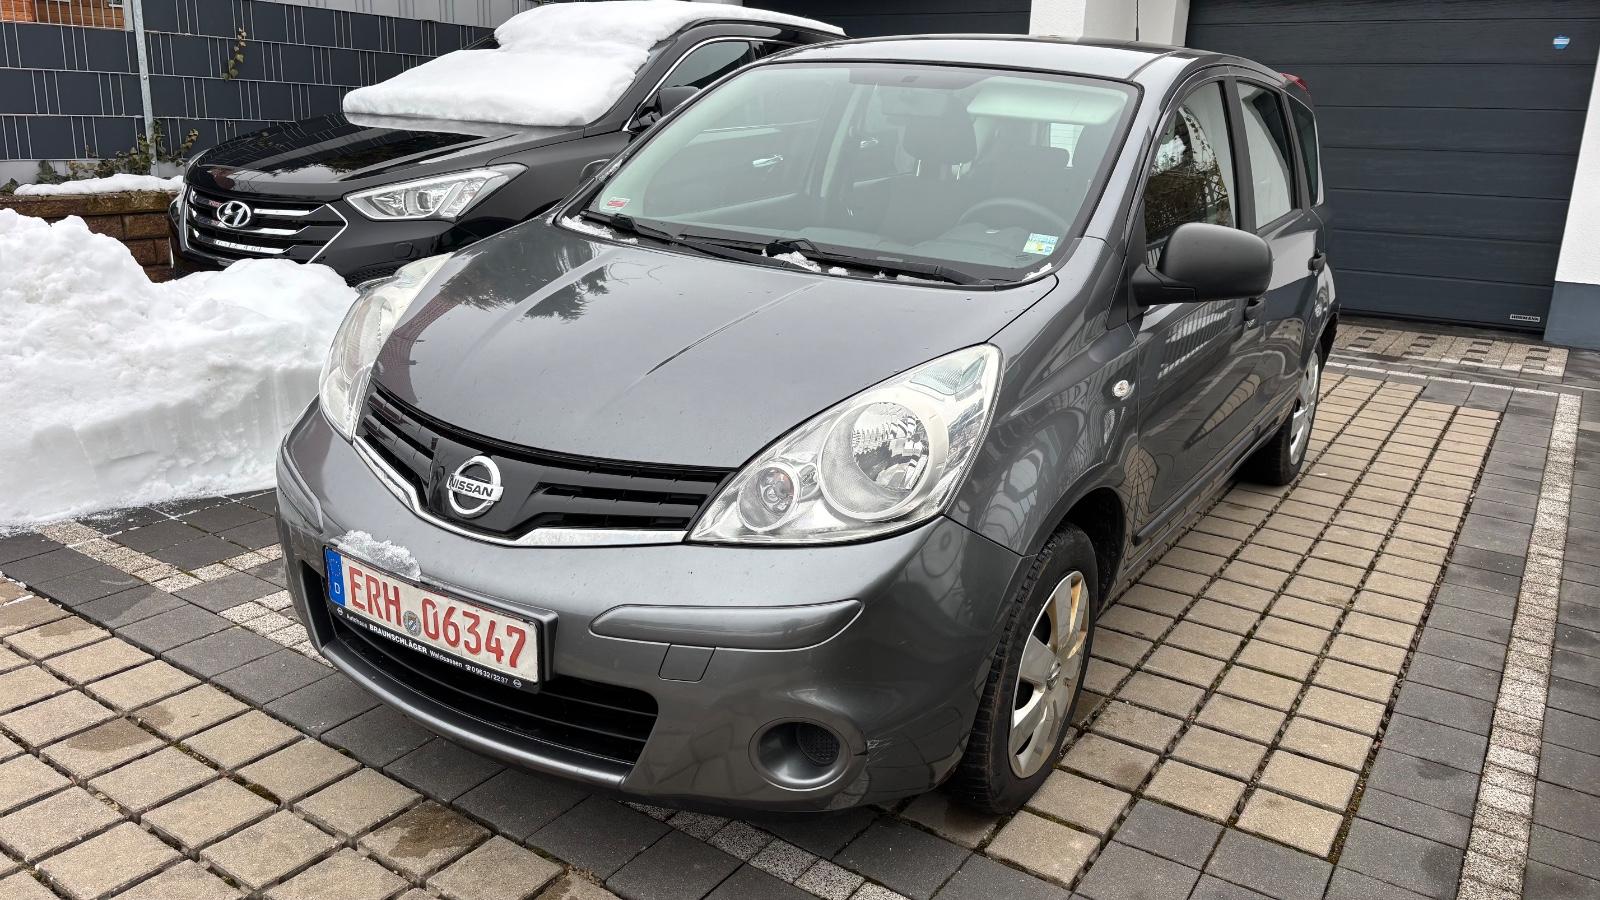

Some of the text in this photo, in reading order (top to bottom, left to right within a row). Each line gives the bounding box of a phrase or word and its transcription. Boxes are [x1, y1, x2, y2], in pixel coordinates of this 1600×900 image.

[449, 475, 494, 497] NISSAN
[334, 582, 341, 594] D
[348, 565, 526, 668] ERH 06347
[369, 623, 428, 654] BRAUNSCHLÄGER
